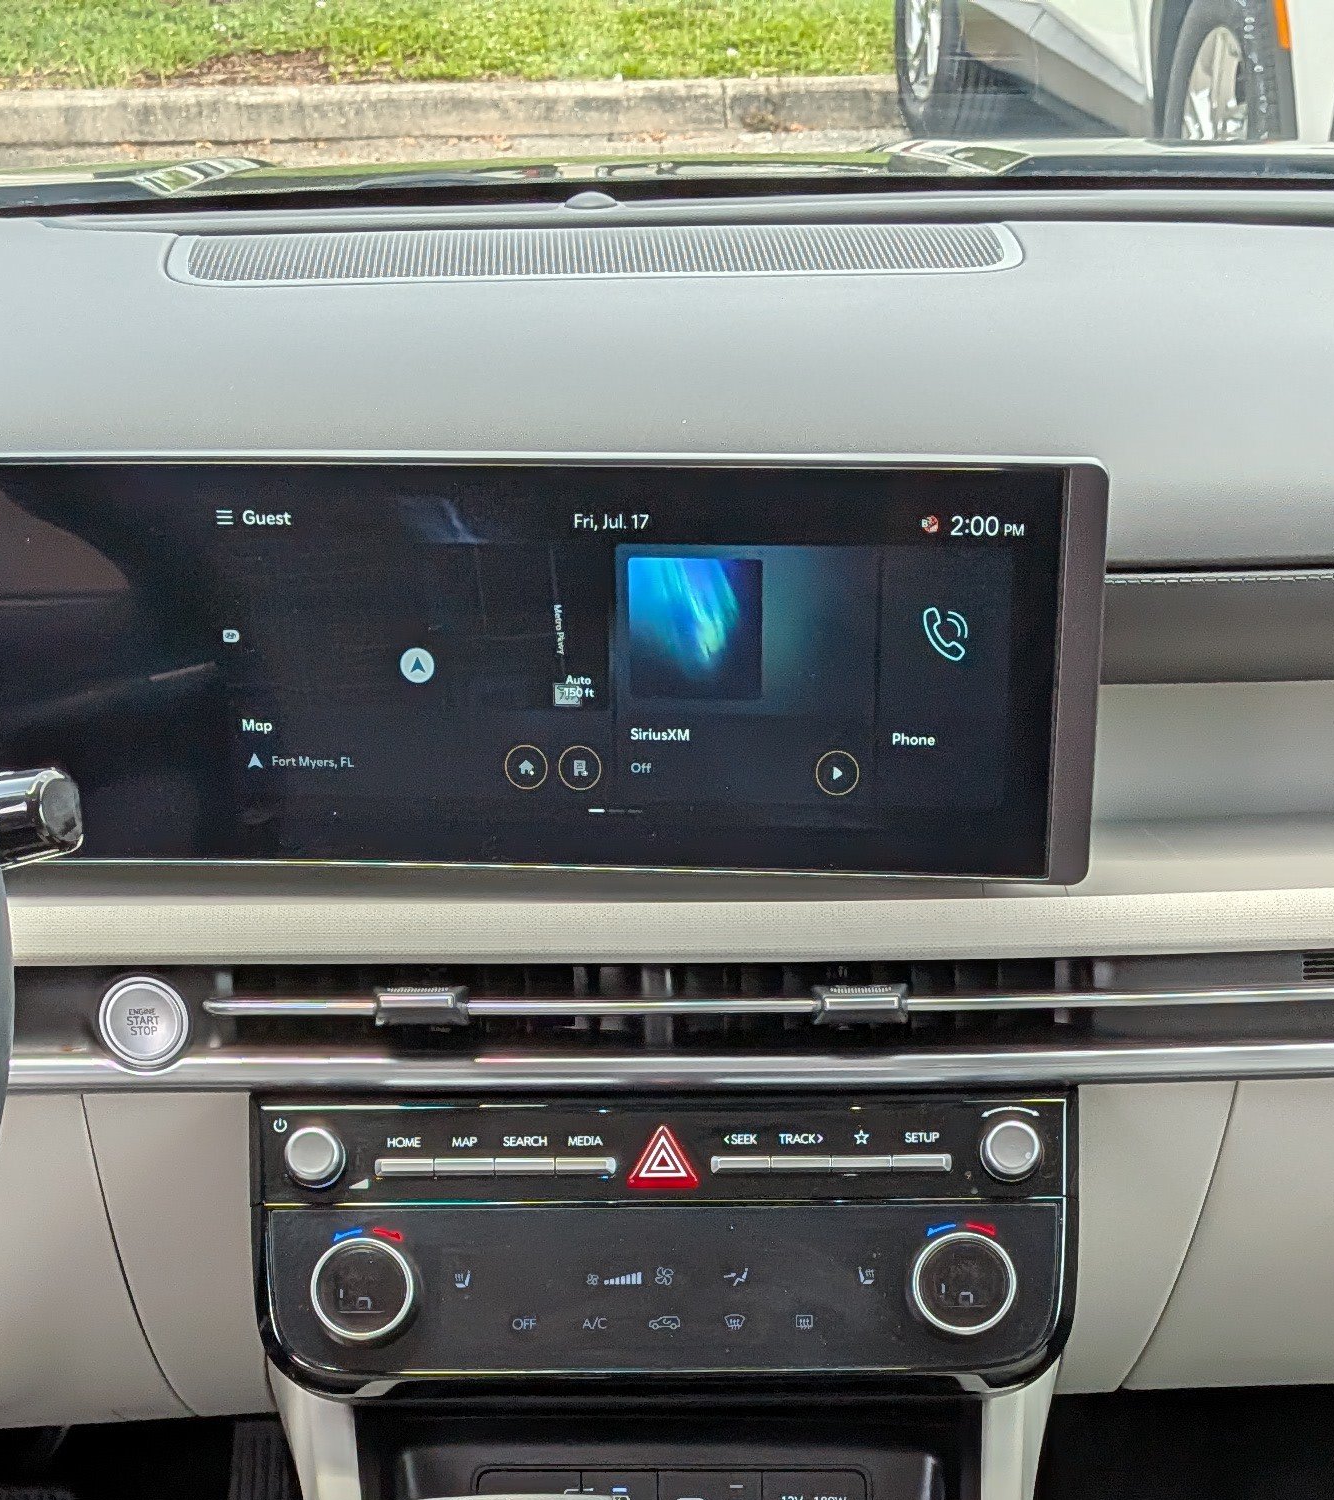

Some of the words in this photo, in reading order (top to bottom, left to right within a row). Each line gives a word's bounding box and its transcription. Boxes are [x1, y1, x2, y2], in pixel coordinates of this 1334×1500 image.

[242, 509, 292, 526] Guest
[573, 514, 598, 532] Fri,
[602, 514, 627, 530] Jul.
[631, 514, 650, 530] 17
[950, 515, 1000, 537] 2:00
[1004, 523, 1025, 537] PM
[554, 604, 563, 631] Metro
[566, 674, 592, 685] Auto
[564, 686, 583, 698] 150
[585, 687, 595, 698] ft
[242, 719, 273, 734] Map
[630, 727, 691, 743] SiriusXM
[892, 732, 936, 748] Phone
[271, 755, 297, 768] Fort
[298, 755, 338, 769] Myers,
[340, 756, 355, 769] FL
[630, 761, 652, 774] Off
[128, 1007, 157, 1016] ENGINE
[126, 1016, 160, 1026] START
[130, 1026, 158, 1036] STOP
[386, 1136, 422, 1148] HOME
[451, 1136, 478, 1148] MAP
[502, 1135, 548, 1147] SEARCH
[567, 1135, 604, 1147] MEDIA
[904, 1131, 940, 1143] SETUP
[512, 1317, 537, 1331] OFF
[582, 1317, 608, 1331] A/C
